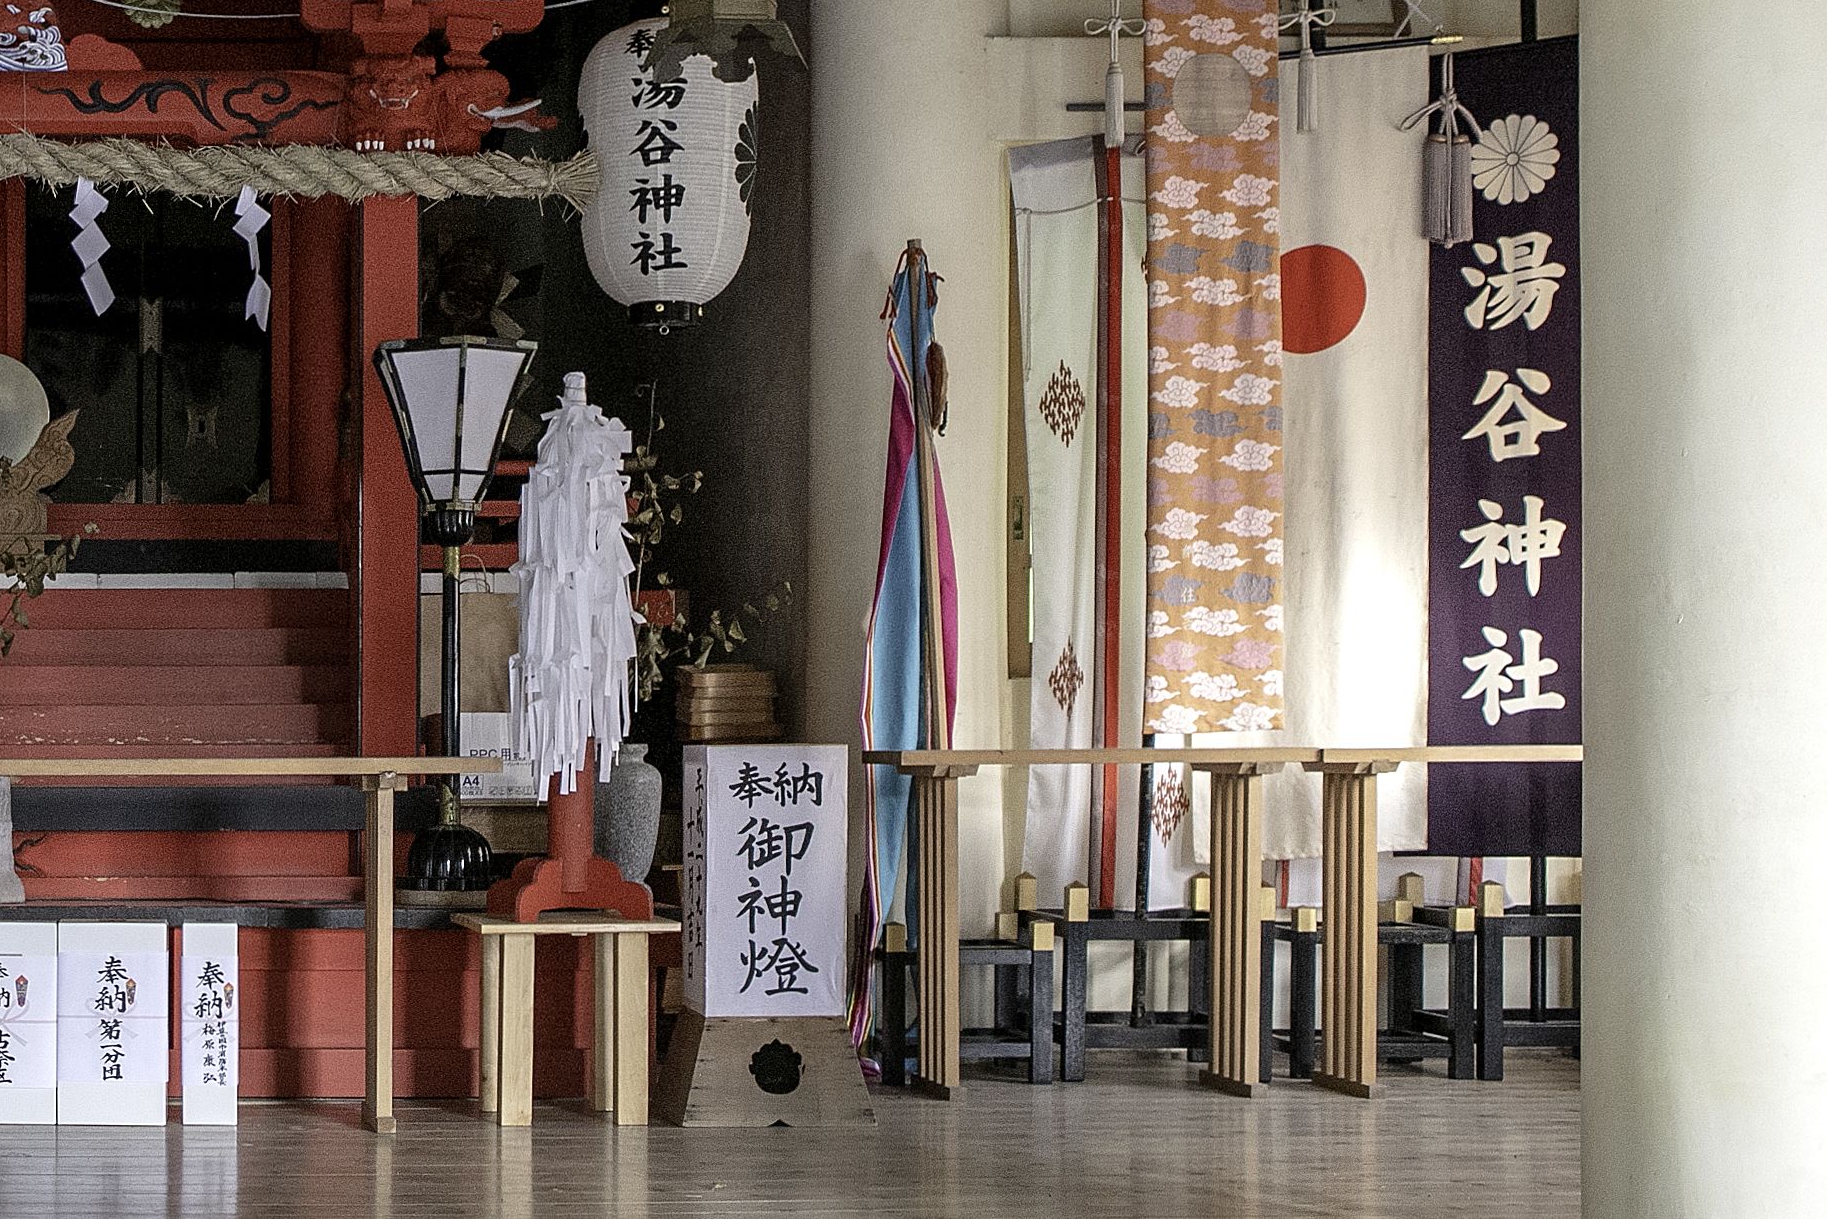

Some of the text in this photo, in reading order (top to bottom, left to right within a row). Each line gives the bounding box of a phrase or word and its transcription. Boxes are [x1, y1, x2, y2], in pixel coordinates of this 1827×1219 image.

[628, 63, 688, 276] 湯谷神社
[1460, 229, 1568, 727] 湯谷神社
[462, 775, 480, 786] A4
[728, 761, 824, 809] 奉納
[735, 815, 820, 996] 御神燈
[94, 955, 128, 1013] 奉納
[194, 961, 225, 1019] 奉納
